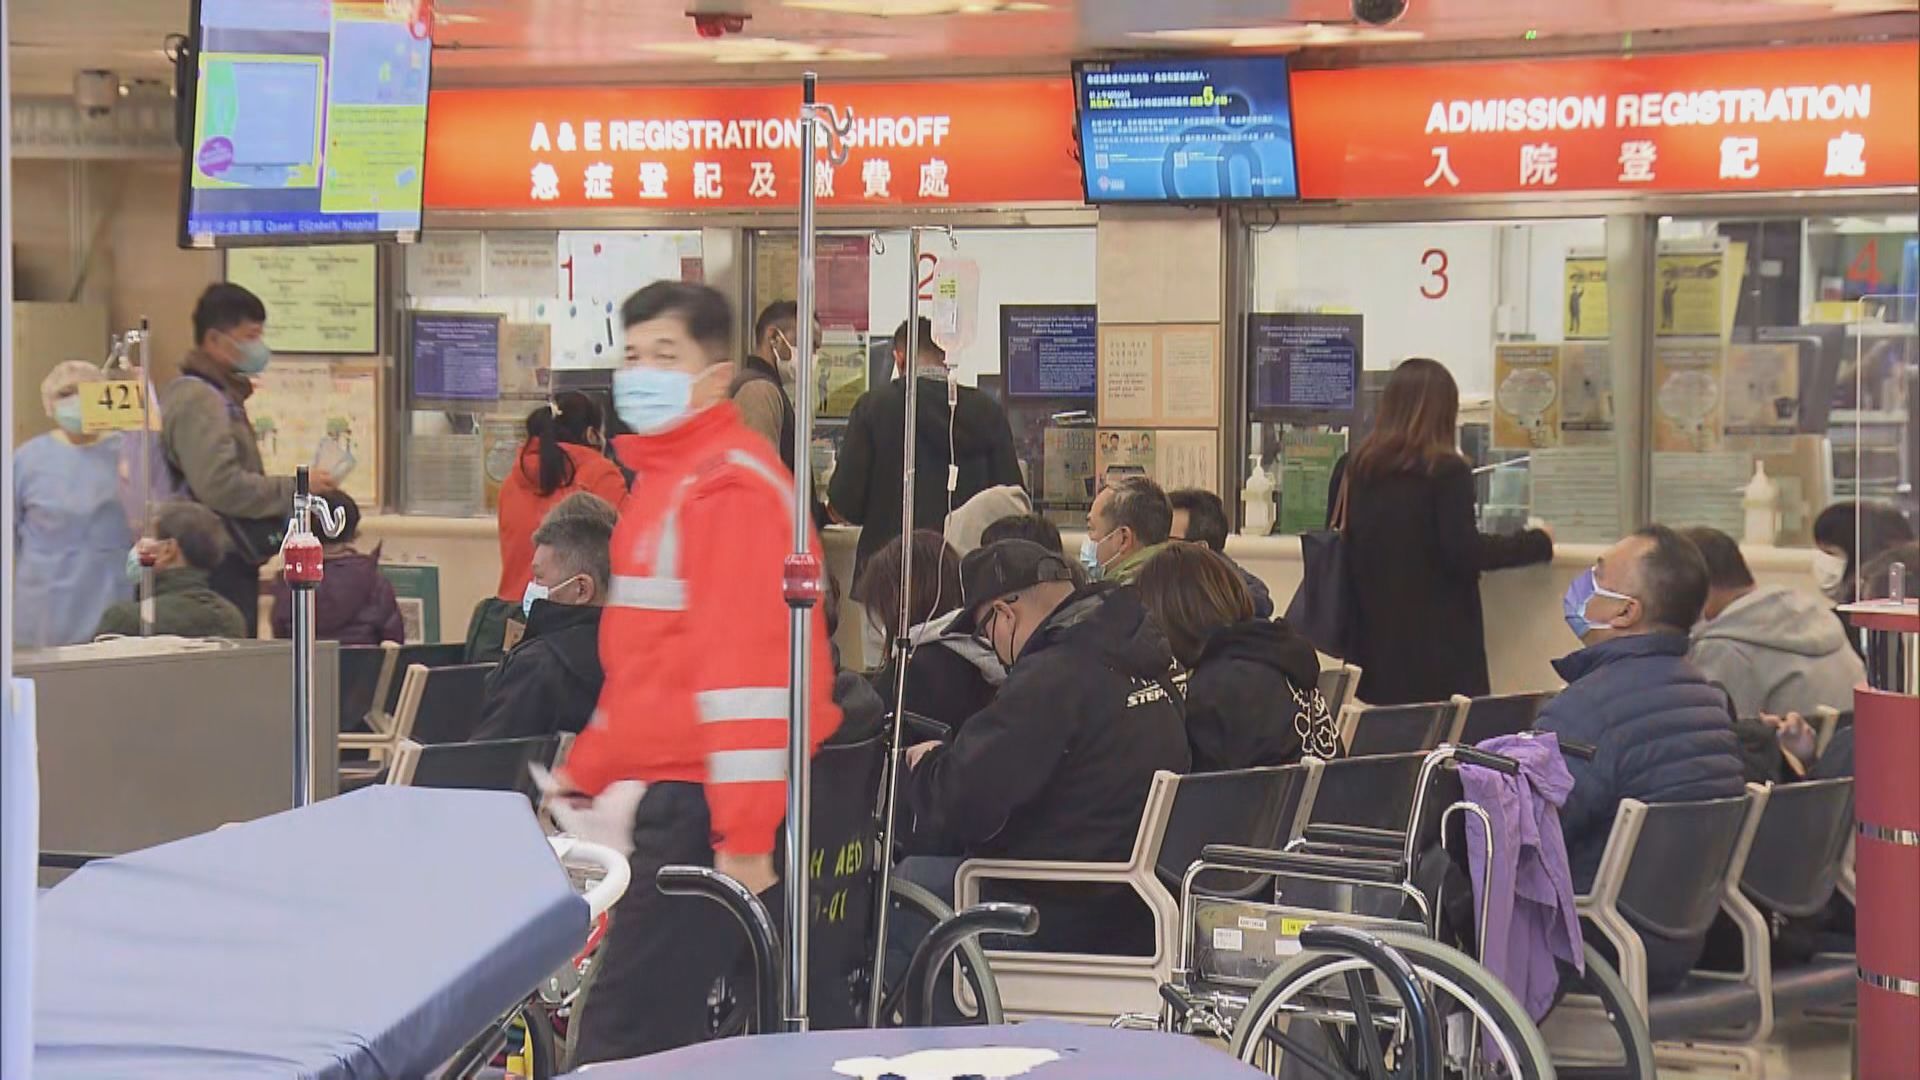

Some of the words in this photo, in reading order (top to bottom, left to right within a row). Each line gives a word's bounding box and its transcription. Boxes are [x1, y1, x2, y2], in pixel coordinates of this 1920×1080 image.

[530, 122, 552, 151] A
[557, 122, 576, 151] &
[584, 122, 602, 151] E
[609, 118, 802, 151] REGISTRATION
[839, 115, 951, 149] SHROFF
[1425, 96, 1607, 133] ADMISSION
[1615, 84, 1871, 128] REGISTRATION
[1423, 131, 1867, 188] 入院登記處
[560, 254, 573, 301] 1
[917, 252, 938, 301] 2
[1420, 248, 1449, 299] 3
[1846, 236, 1883, 293] 4
[834, 839, 863, 878] AED
